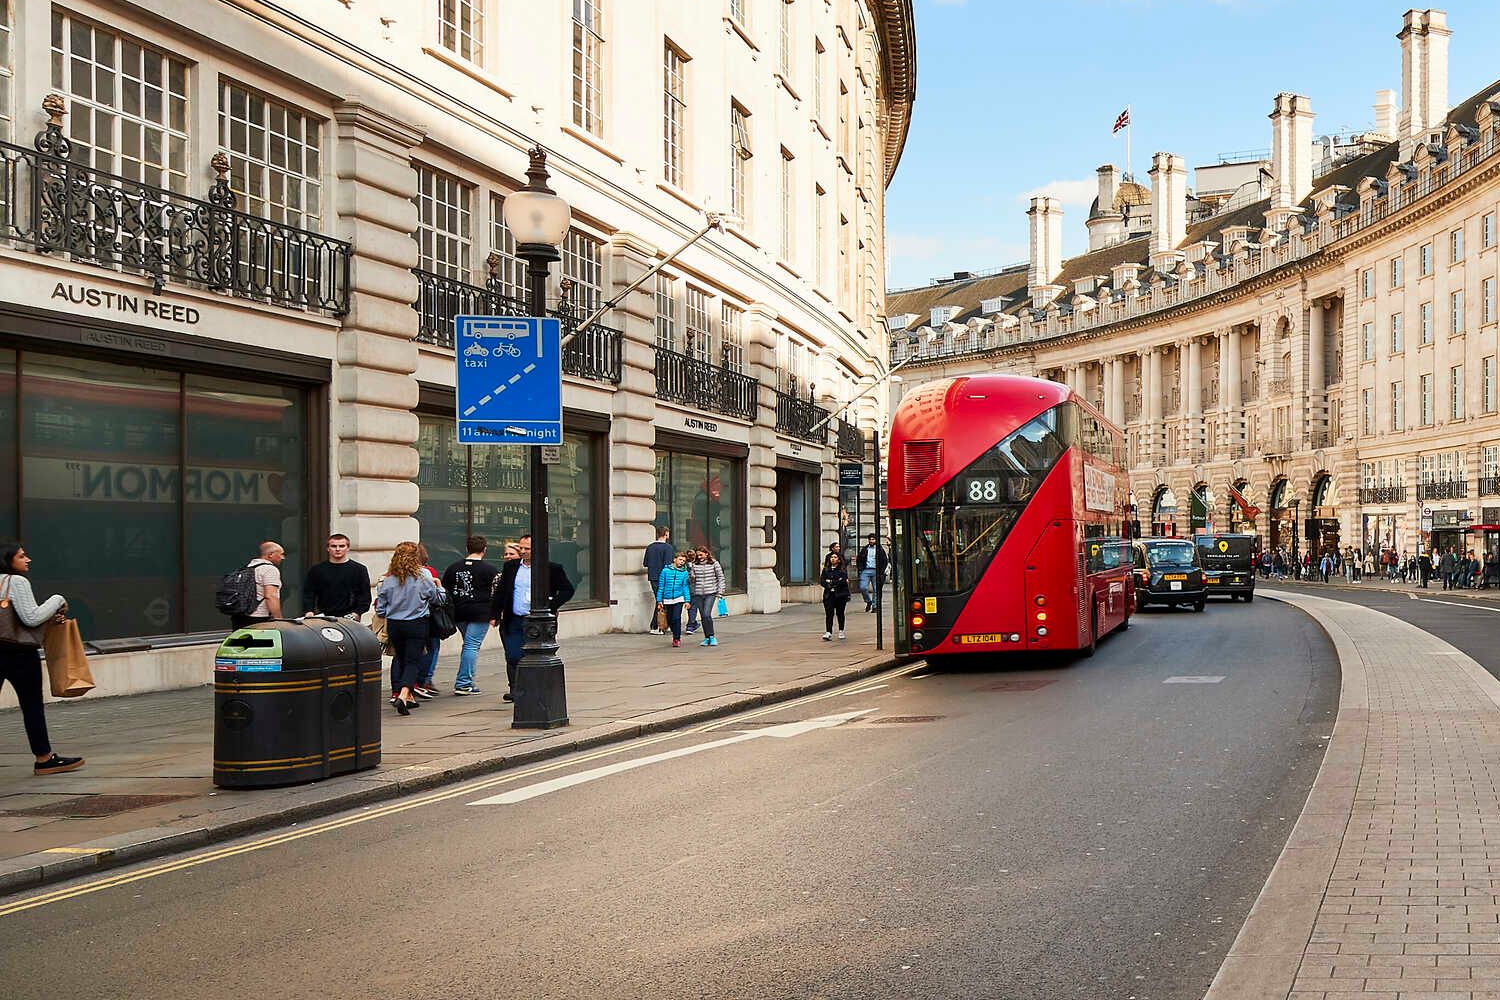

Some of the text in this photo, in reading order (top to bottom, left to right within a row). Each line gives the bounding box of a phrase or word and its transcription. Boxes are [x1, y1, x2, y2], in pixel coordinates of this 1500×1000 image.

[51, 282, 200, 325] AUSTIN REED
[86, 331, 167, 352] AUSTIN REED
[464, 358, 488, 368] taxi
[684, 417, 718, 433] AUSTIN REED
[970, 480, 997, 500] 88
[967, 635, 981, 643] LTZ
